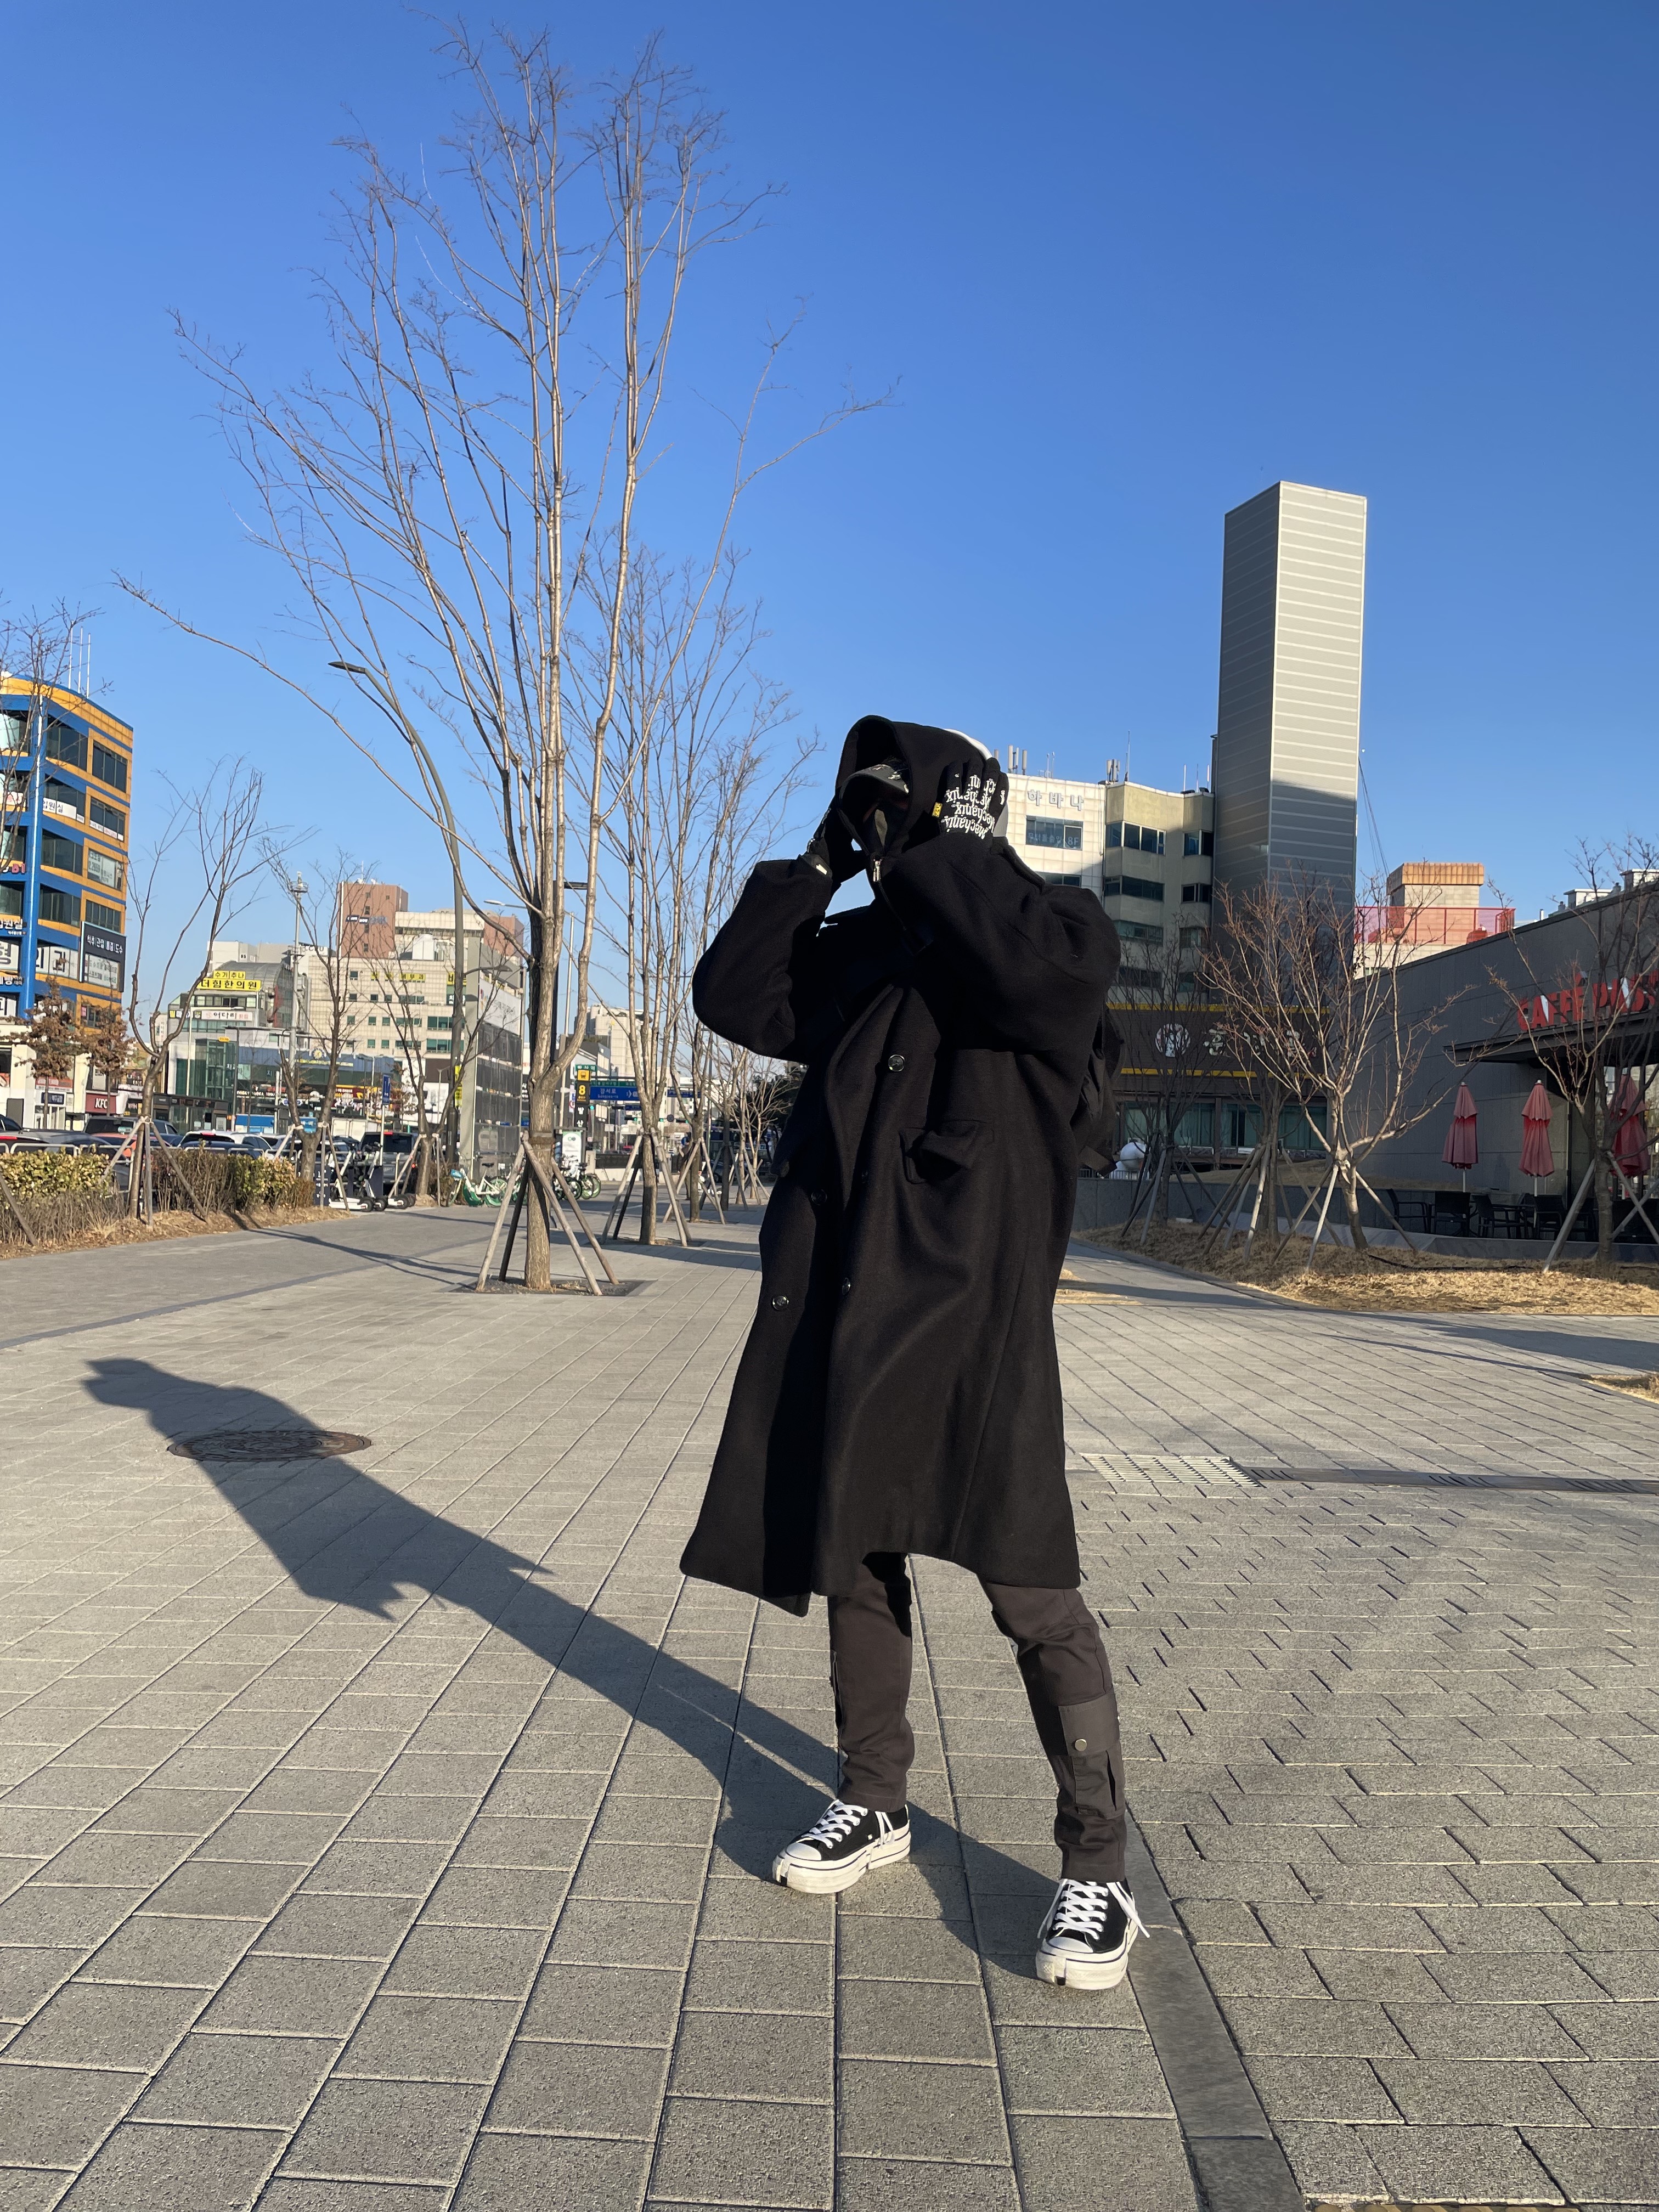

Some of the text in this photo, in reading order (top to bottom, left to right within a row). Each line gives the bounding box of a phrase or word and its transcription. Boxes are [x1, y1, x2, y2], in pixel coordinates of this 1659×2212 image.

[1027, 789, 1085, 811] 하바나
[201, 979, 257, 990] 더힘한의원
[578, 1085, 586, 1096] 8
[95, 1097, 108, 1109] KFC
